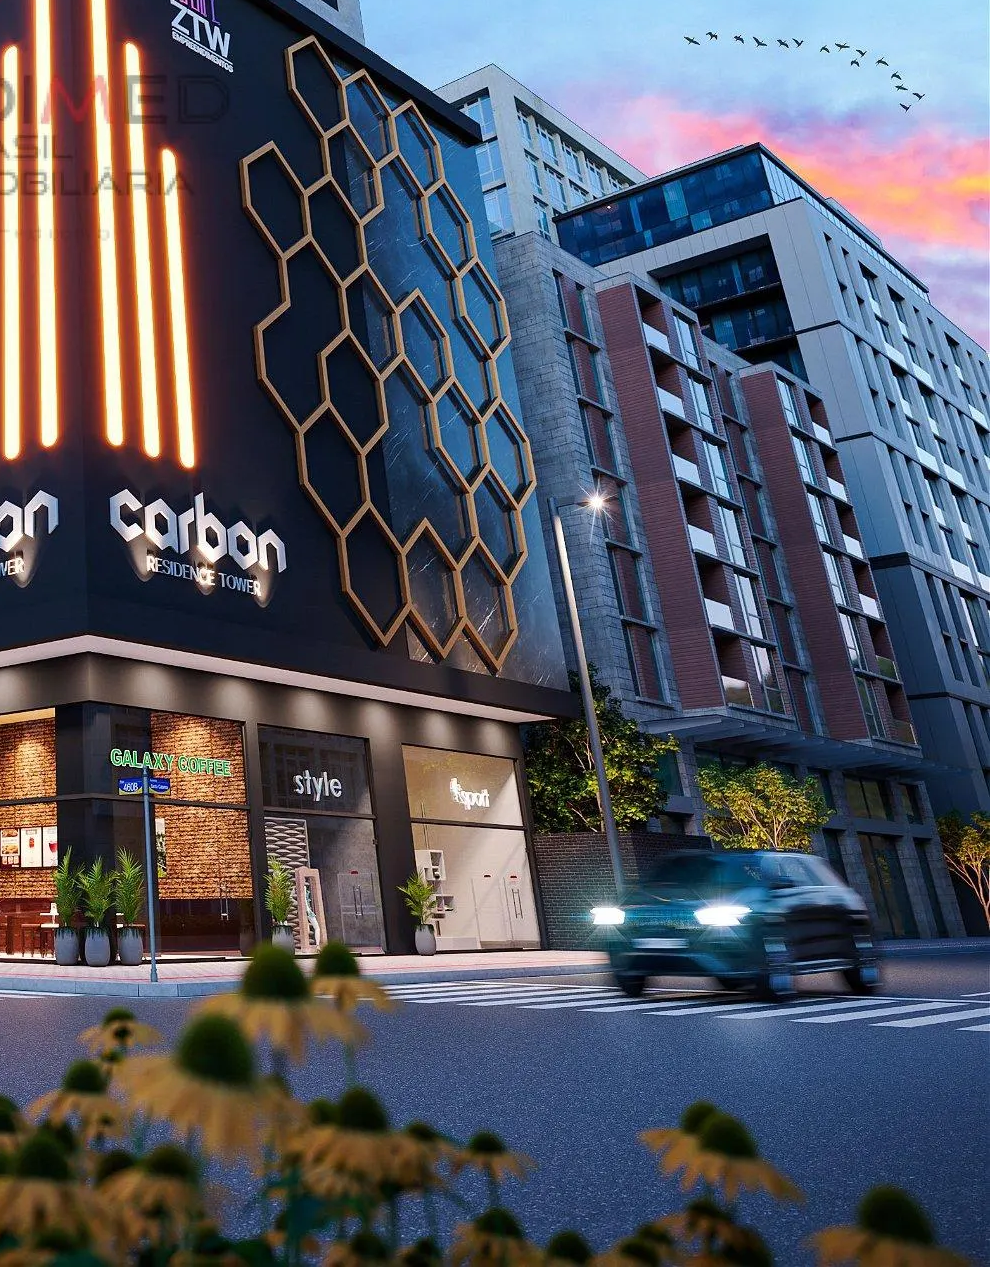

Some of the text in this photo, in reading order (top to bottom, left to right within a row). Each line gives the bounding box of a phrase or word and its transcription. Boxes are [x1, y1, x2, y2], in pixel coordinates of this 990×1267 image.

[109, 488, 287, 574] carbon
[145, 555, 263, 597] RESIDENCE TOWER
[110, 748, 232, 777] GALAXY COFFEE
[292, 769, 342, 802] style
